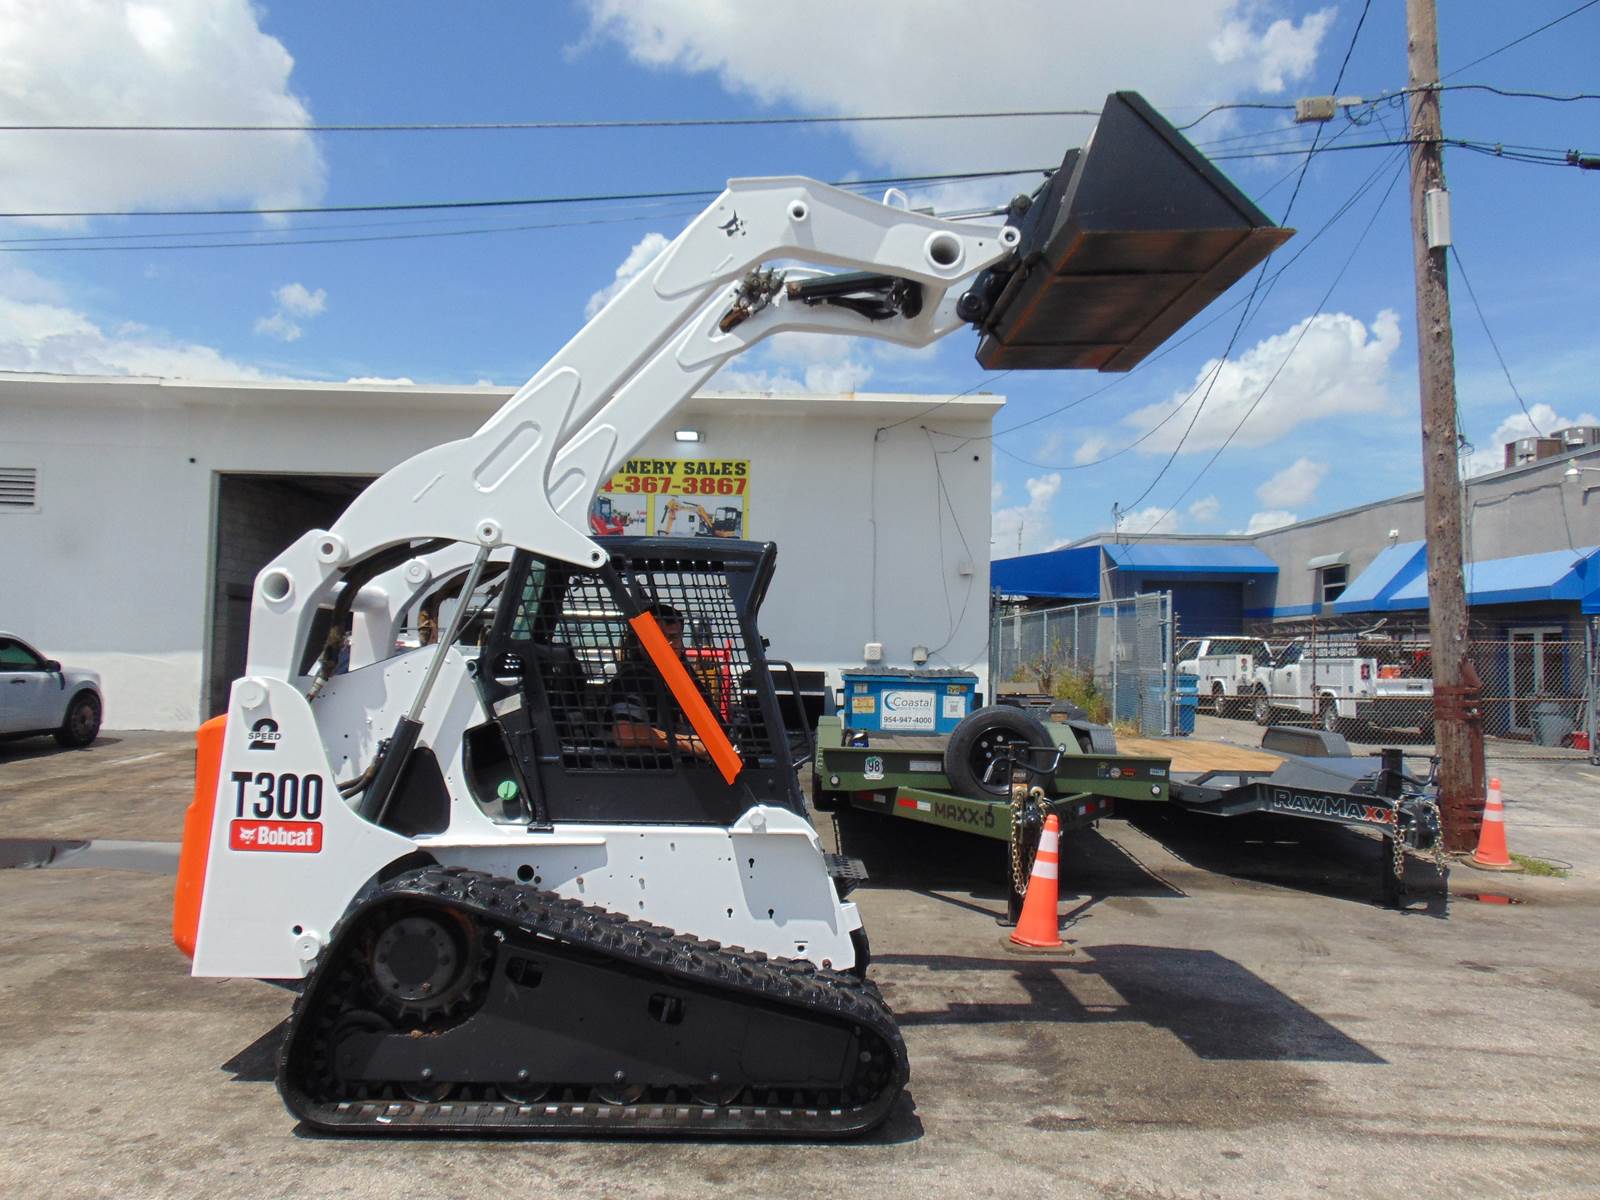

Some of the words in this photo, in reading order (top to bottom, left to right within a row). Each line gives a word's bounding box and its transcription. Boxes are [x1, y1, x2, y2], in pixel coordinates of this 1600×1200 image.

[683, 461, 747, 476] SALES
[602, 476, 747, 495] 4-367-3867
[893, 697, 933, 707] Coastal
[883, 716, 932, 724] 954-947-4000
[248, 718, 278, 750] 2
[248, 732, 281, 740] SPEED
[232, 771, 323, 820] T300
[257, 826, 314, 846] Bobcat
